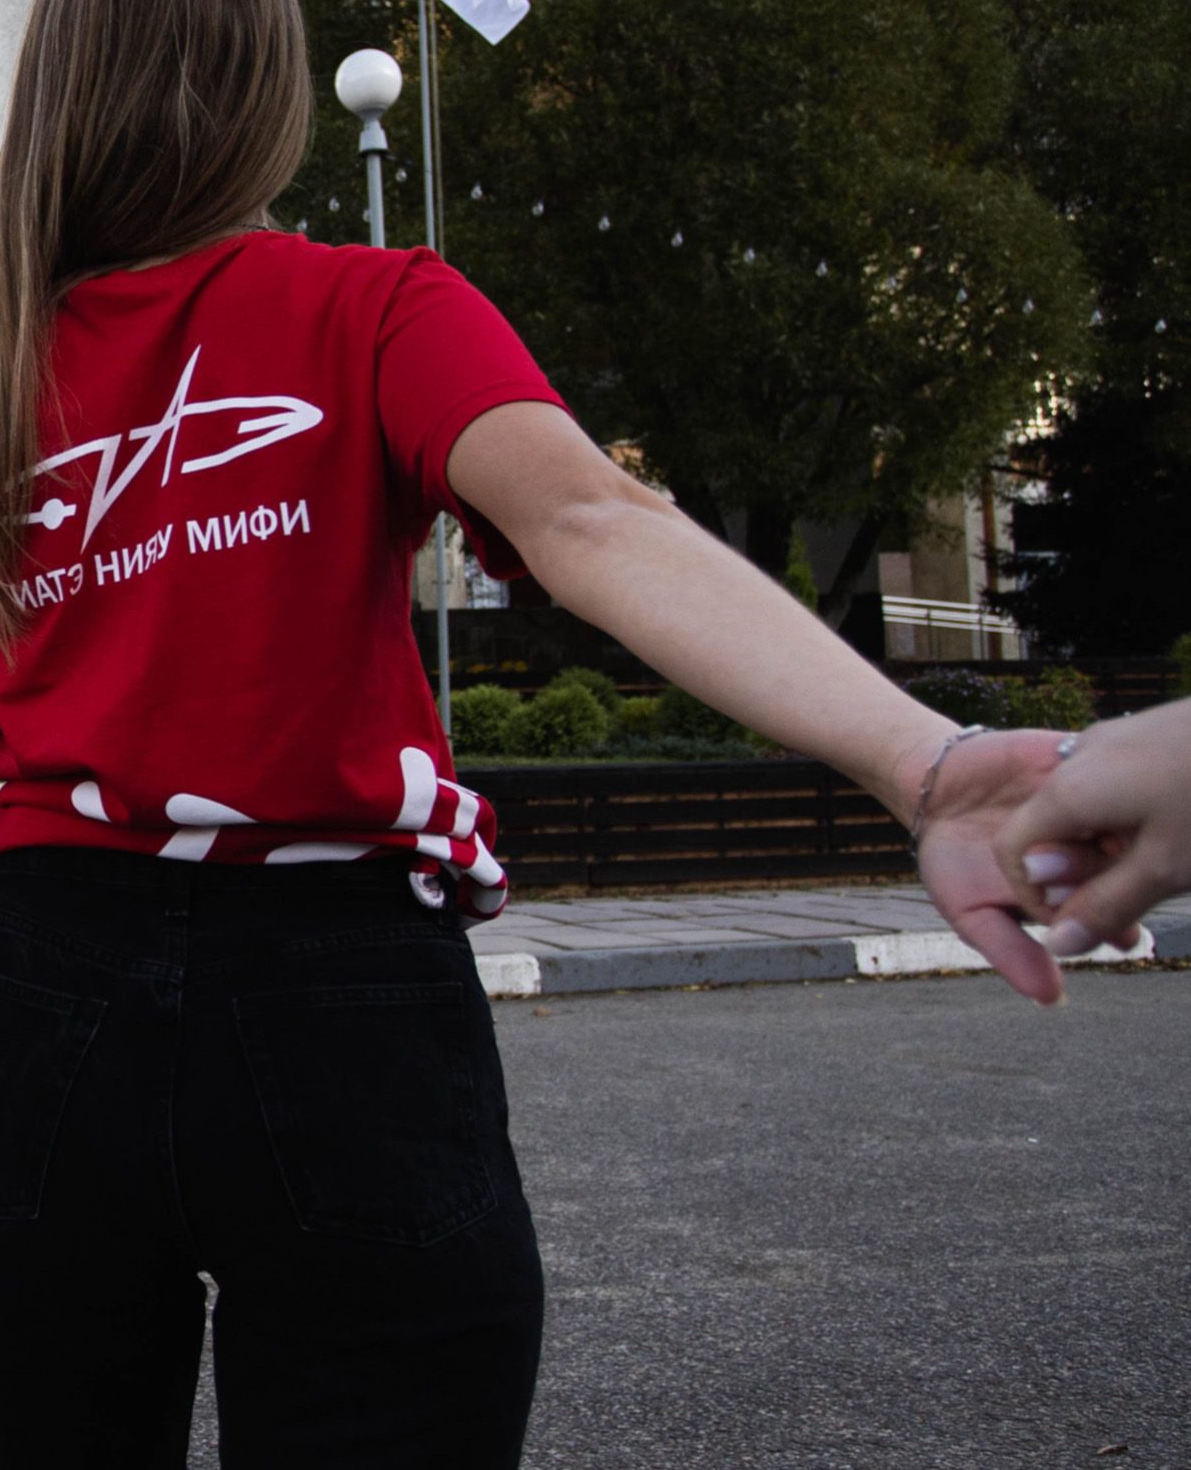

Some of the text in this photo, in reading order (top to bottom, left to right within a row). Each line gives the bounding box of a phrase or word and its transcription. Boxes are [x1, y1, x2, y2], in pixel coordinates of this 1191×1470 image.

[9, 499, 311, 611] ИАТЭ НИЯУ МИФИ
